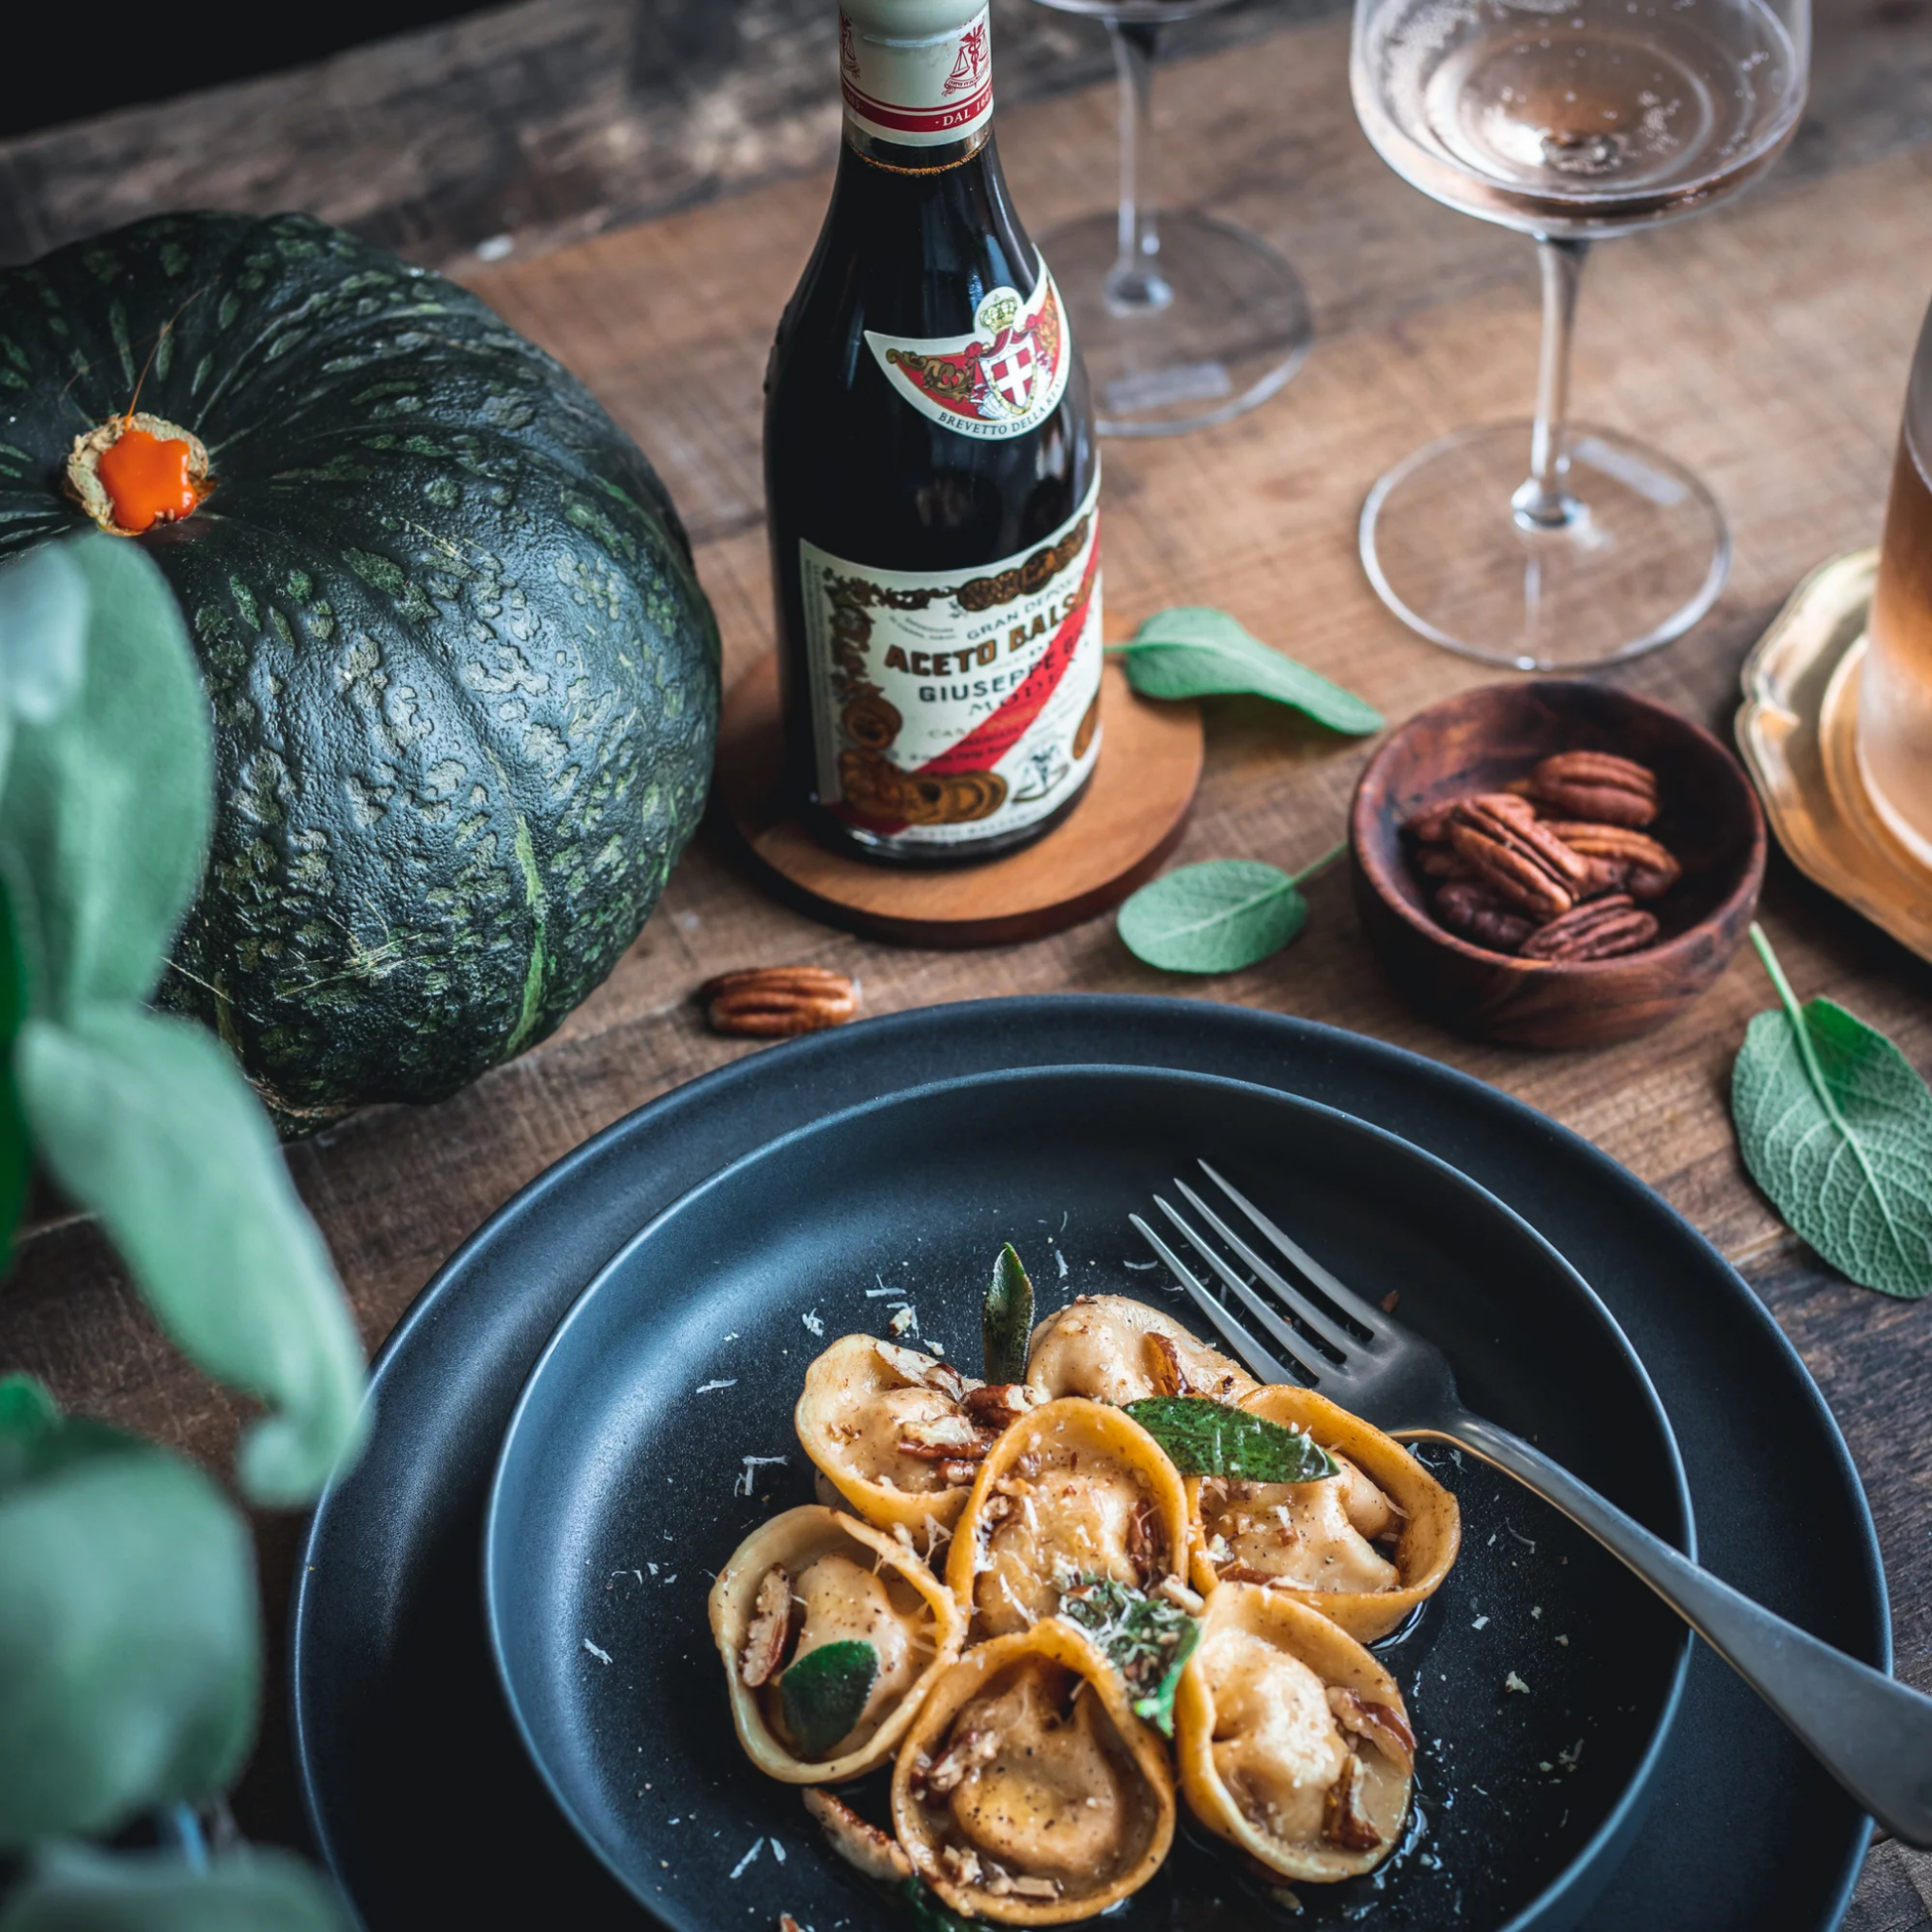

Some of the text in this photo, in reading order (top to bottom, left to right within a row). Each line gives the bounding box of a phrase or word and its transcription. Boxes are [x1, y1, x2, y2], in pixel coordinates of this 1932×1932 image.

[943, 109, 971, 126] DAL
[938, 411, 1008, 435] BREVETTO
[1012, 407, 1046, 433] DELLA
[967, 611, 1019, 640] GRAN
[885, 639, 997, 677] ACETO
[919, 651, 1055, 703] GIUSEPPE
